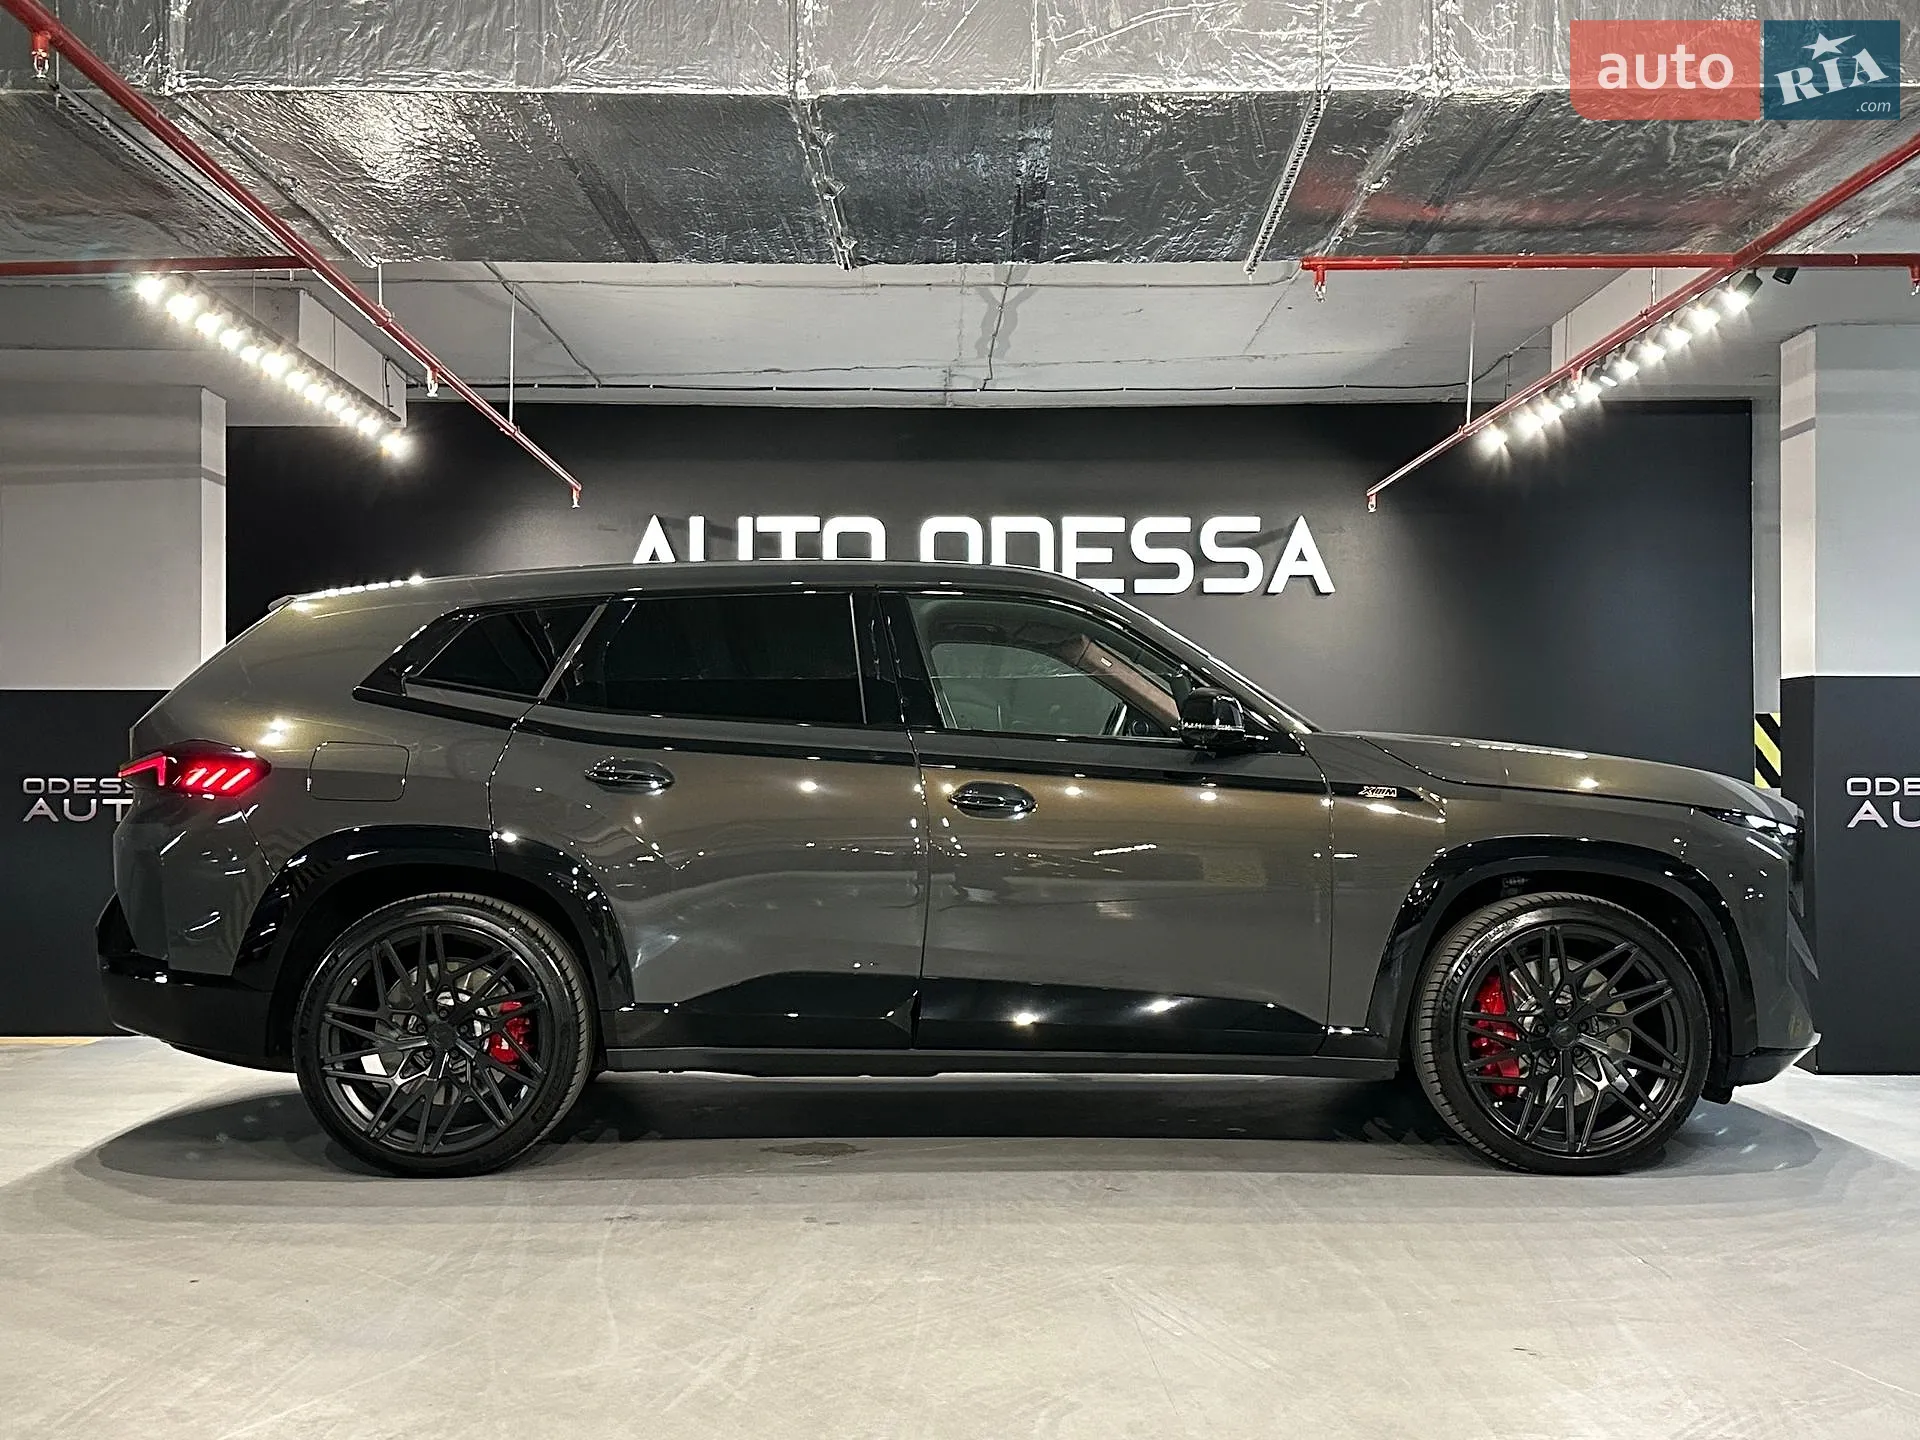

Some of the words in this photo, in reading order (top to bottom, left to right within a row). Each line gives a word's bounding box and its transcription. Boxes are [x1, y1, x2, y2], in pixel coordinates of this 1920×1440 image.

[919, 514, 1336, 595] ODESSA
[22, 797, 134, 822] AUT
[1847, 799, 1920, 828] AU
